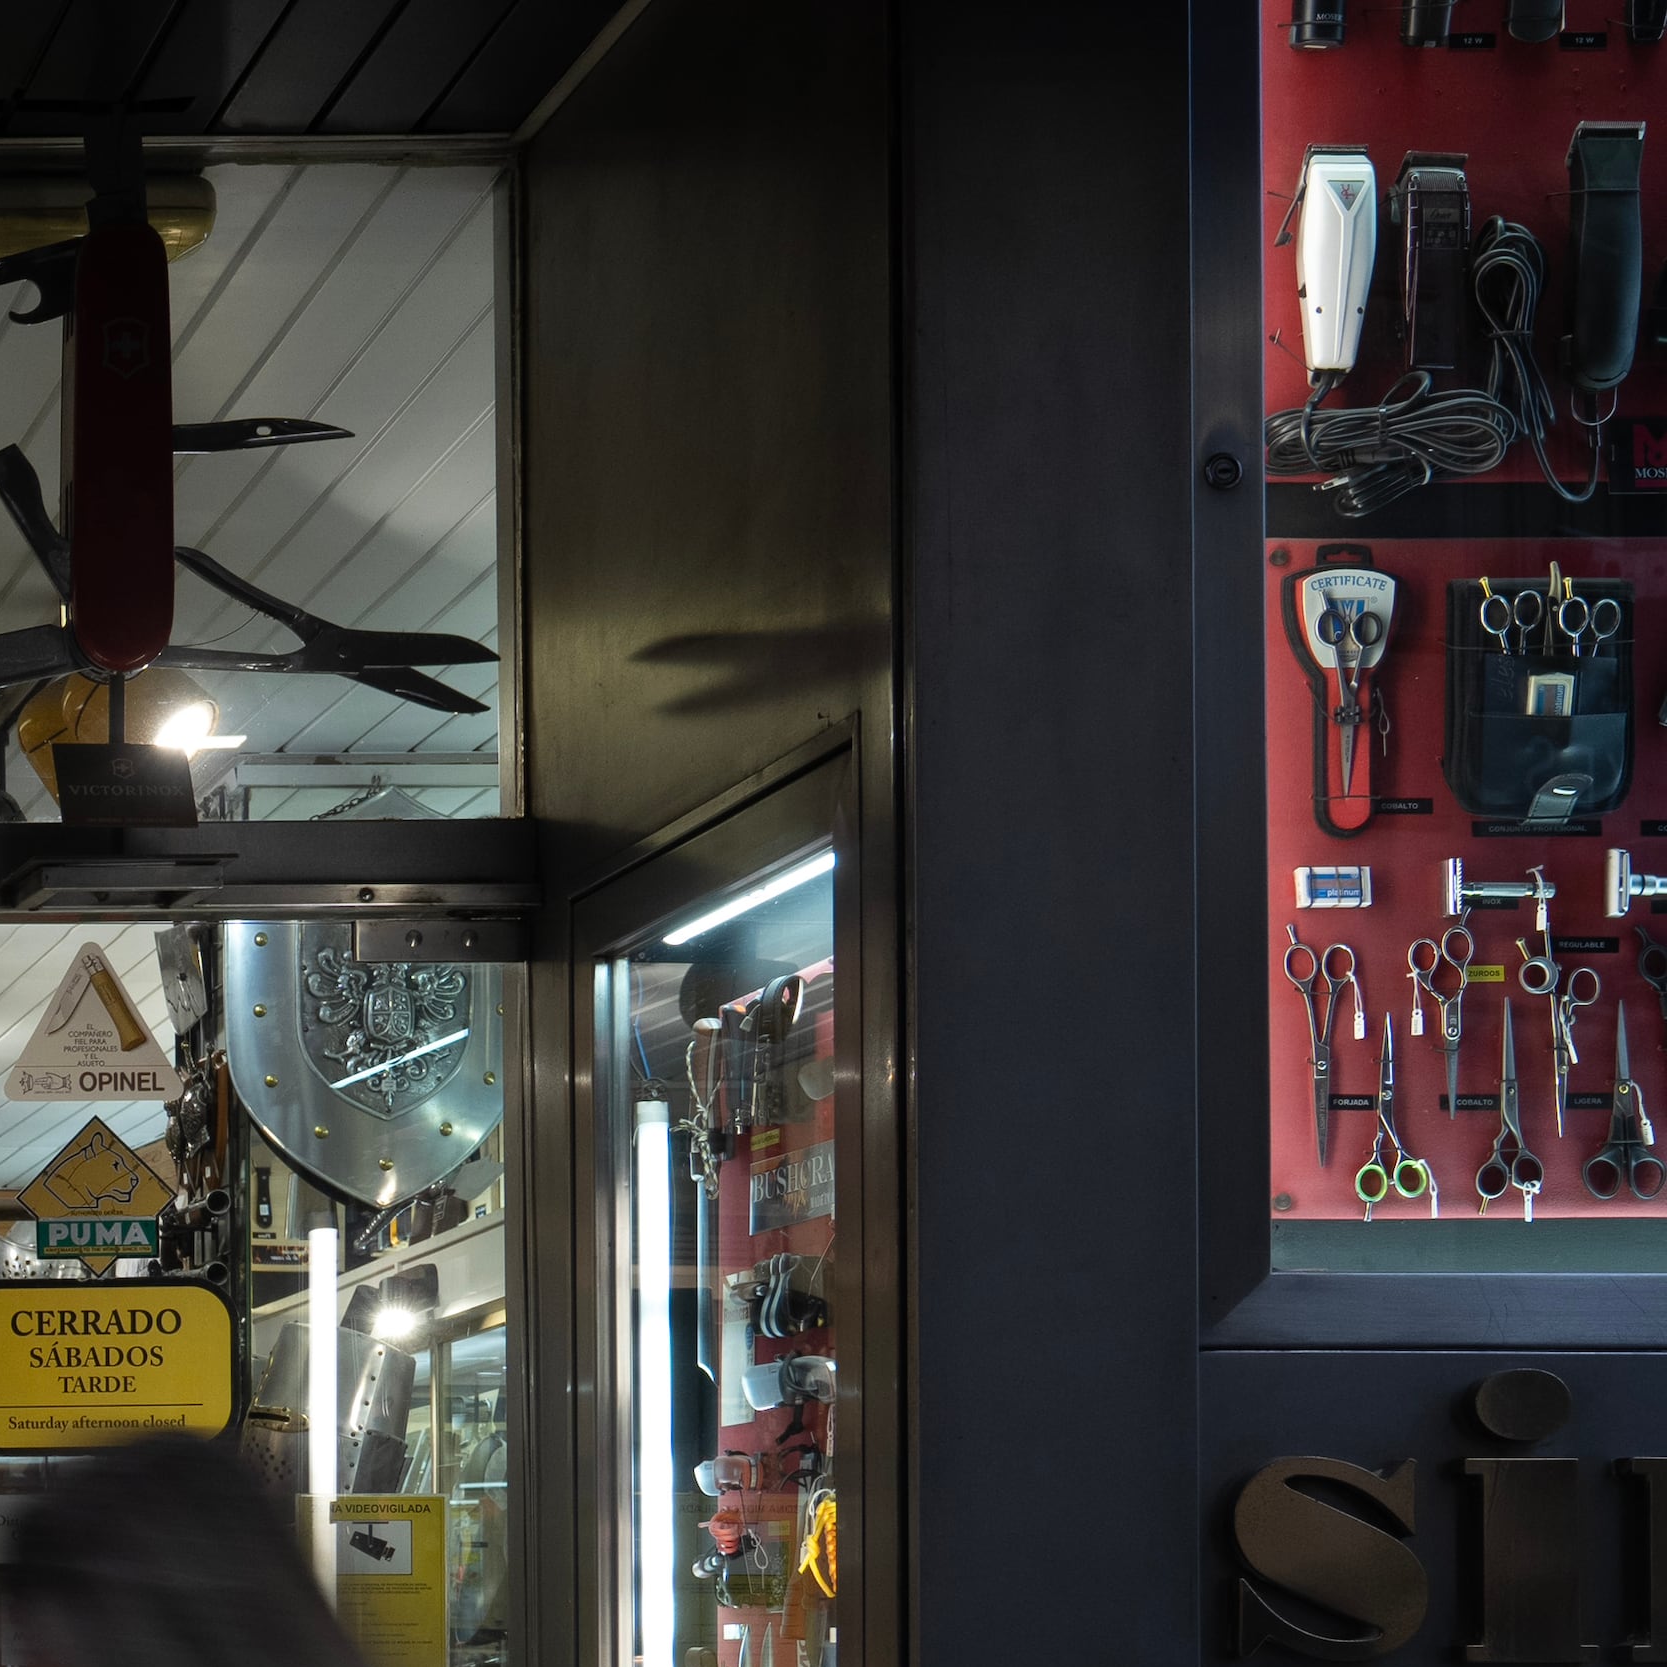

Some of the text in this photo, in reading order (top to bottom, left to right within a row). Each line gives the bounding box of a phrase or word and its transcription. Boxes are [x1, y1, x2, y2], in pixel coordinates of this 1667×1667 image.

[1635, 467, 1667, 479] MOS
[1310, 575, 1387, 591] CERTIFICATE
[68, 783, 187, 797] VICTORINOX
[1381, 802, 1419, 810] COBALTO
[1559, 941, 1606, 949] REGULABLE
[68, 1029, 113, 1038] COMPAÑERO
[88, 1038, 107, 1046] PARA
[63, 1045, 119, 1053] PROFESIONALES
[91, 1053, 99, 1061] EL
[77, 1060, 105, 1068] ASUETO
[78, 1071, 165, 1092] OPINEL
[1333, 1098, 1369, 1107] FORJADA
[1456, 1098, 1493, 1107] COBALTO
[1574, 1097, 1602, 1105] LIGERA
[48, 1222, 150, 1246] PUMA
[10, 1308, 182, 1337] CERRADO
[29, 1341, 164, 1369] SÁBADOS
[58, 1375, 137, 1394] TARDE
[8, 1413, 186, 1433] Saturday afternoon closed
[345, 1503, 431, 1514] VIDEOVIGILADA
